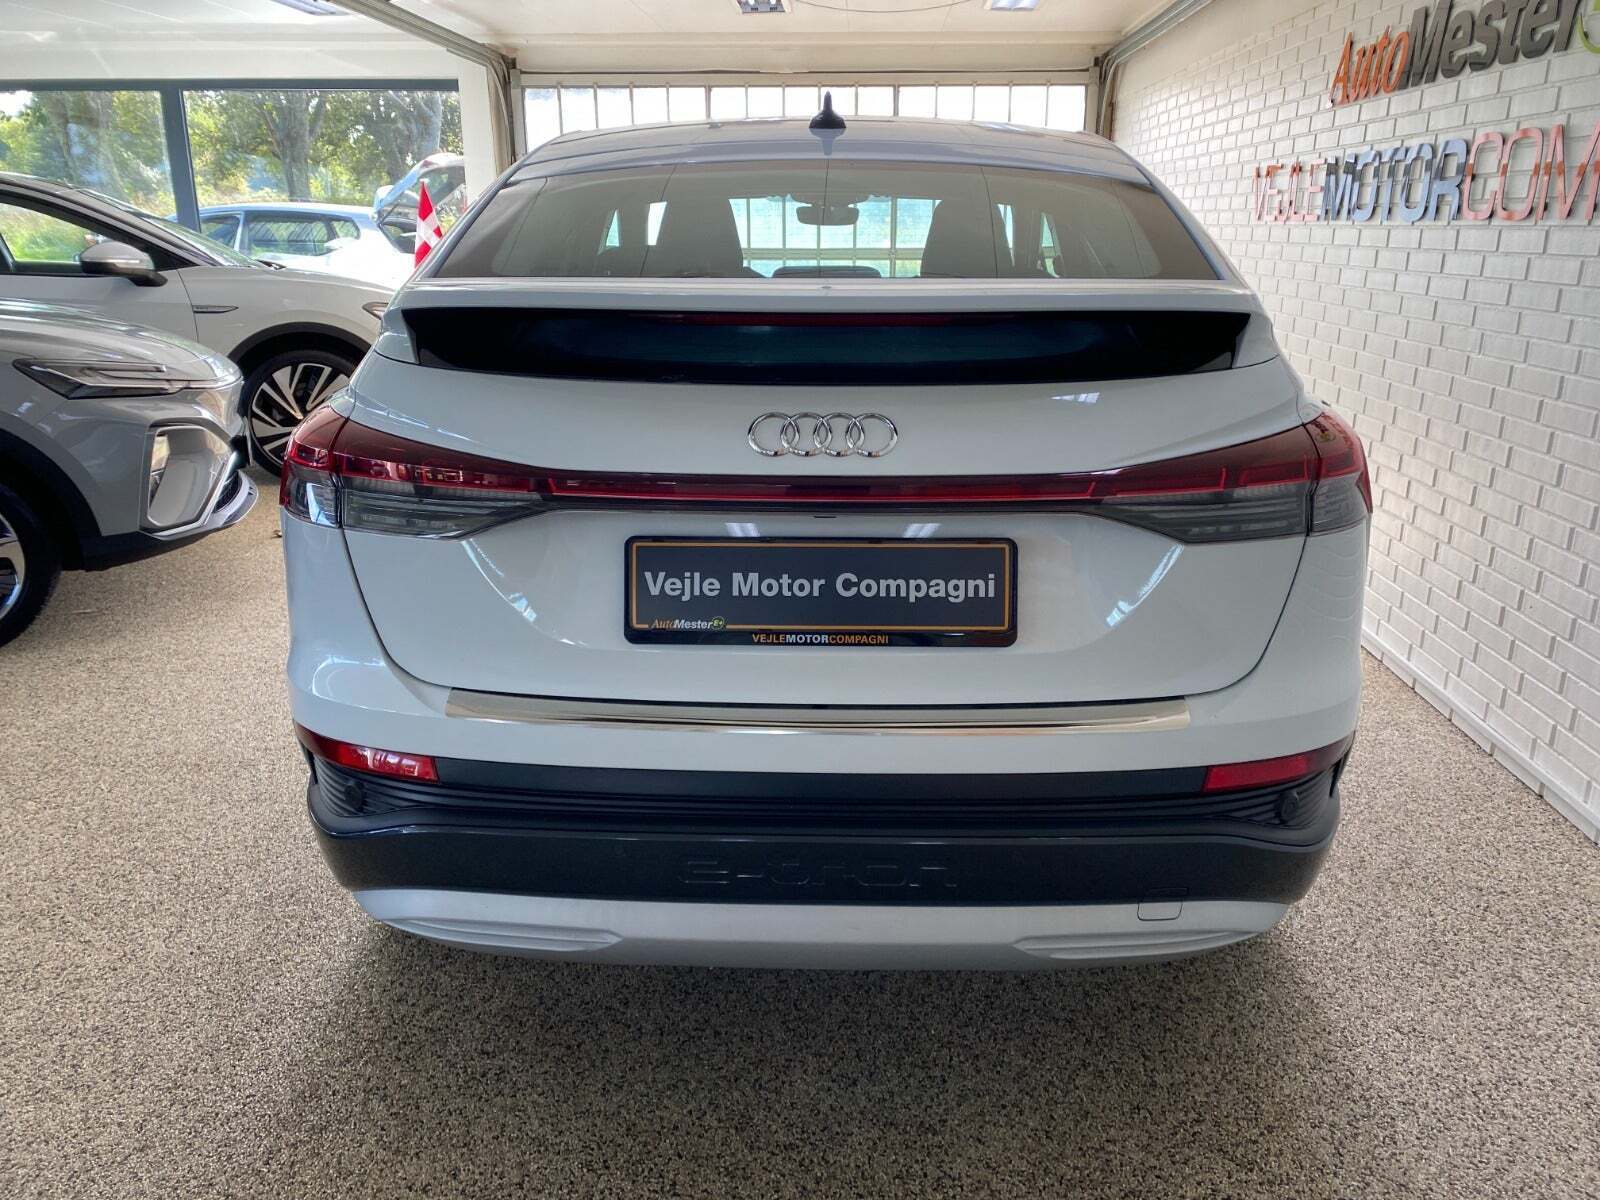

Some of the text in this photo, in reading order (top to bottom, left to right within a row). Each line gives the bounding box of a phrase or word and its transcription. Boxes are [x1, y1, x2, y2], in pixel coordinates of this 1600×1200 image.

[644, 571, 996, 603] Vejle Motor Compagni
[751, 633, 890, 645] VEJLEMOTORCOMPAGNI
